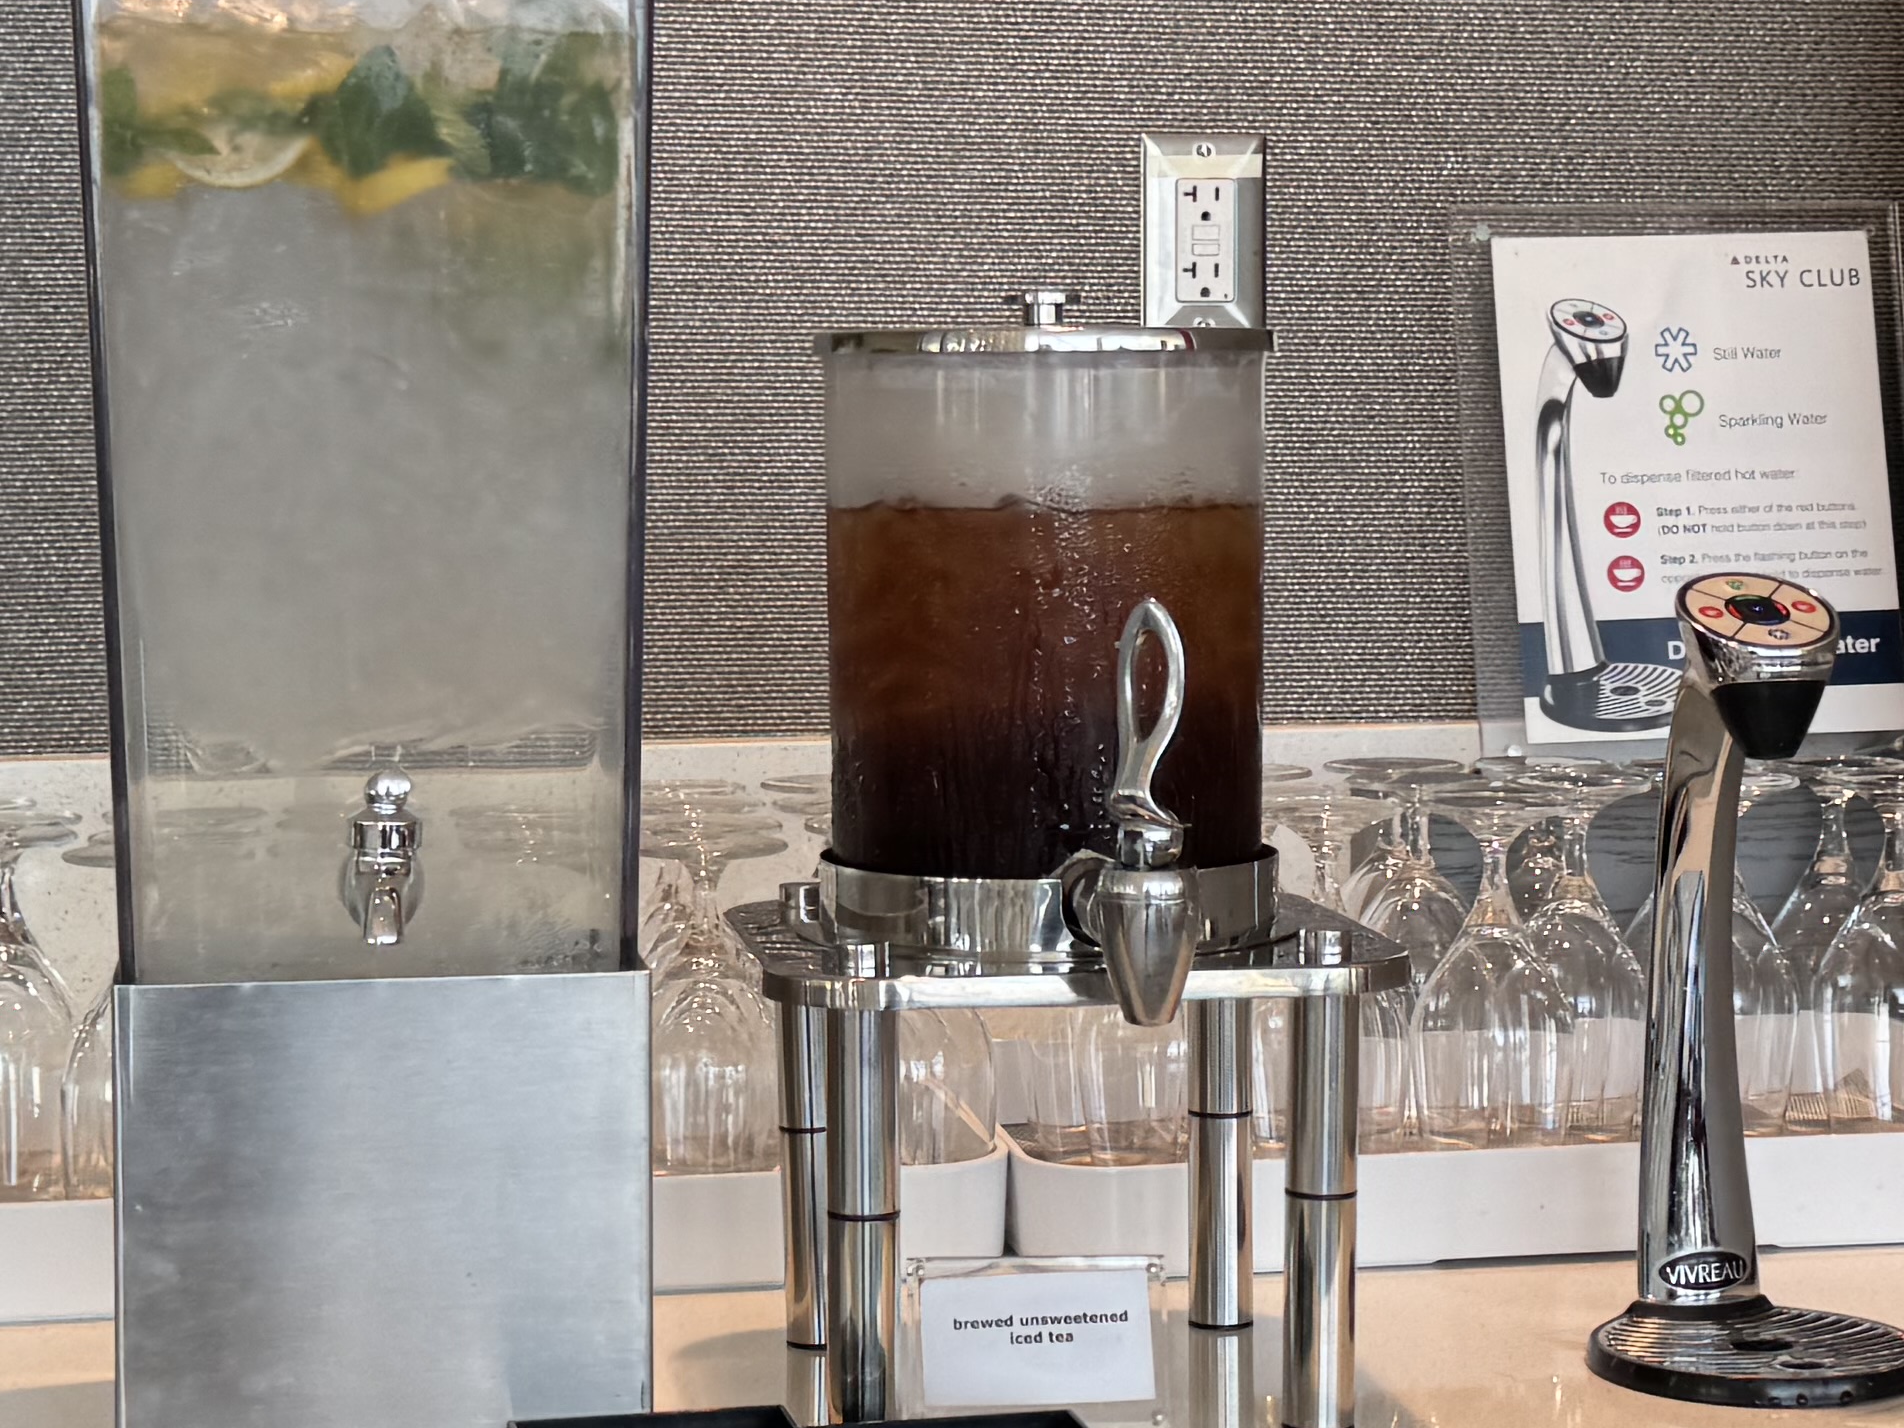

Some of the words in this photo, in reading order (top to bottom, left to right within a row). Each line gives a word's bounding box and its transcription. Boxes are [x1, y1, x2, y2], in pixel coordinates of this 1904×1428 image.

[1744, 255, 1789, 265] DELTA
[1746, 269, 1789, 288] SKY
[1799, 267, 1861, 288] CLUB
[1713, 347, 1738, 361] Still
[1741, 346, 1782, 360] Water
[1718, 414, 1784, 429] Sparkling
[1787, 413, 1828, 425] Water
[1600, 472, 1617, 485] To
[1735, 468, 1756, 481] hot
[1656, 506, 1682, 519] Step
[1683, 523, 1707, 534] NOT
[1660, 554, 1686, 566] Step
[1836, 635, 1881, 655] ater
[1665, 1261, 1744, 1285] VIVREAU
[953, 1315, 1014, 1331] brewed
[1019, 1310, 1128, 1327] unsweetened
[1010, 1331, 1043, 1345] iced
[1048, 1330, 1074, 1344] tea
